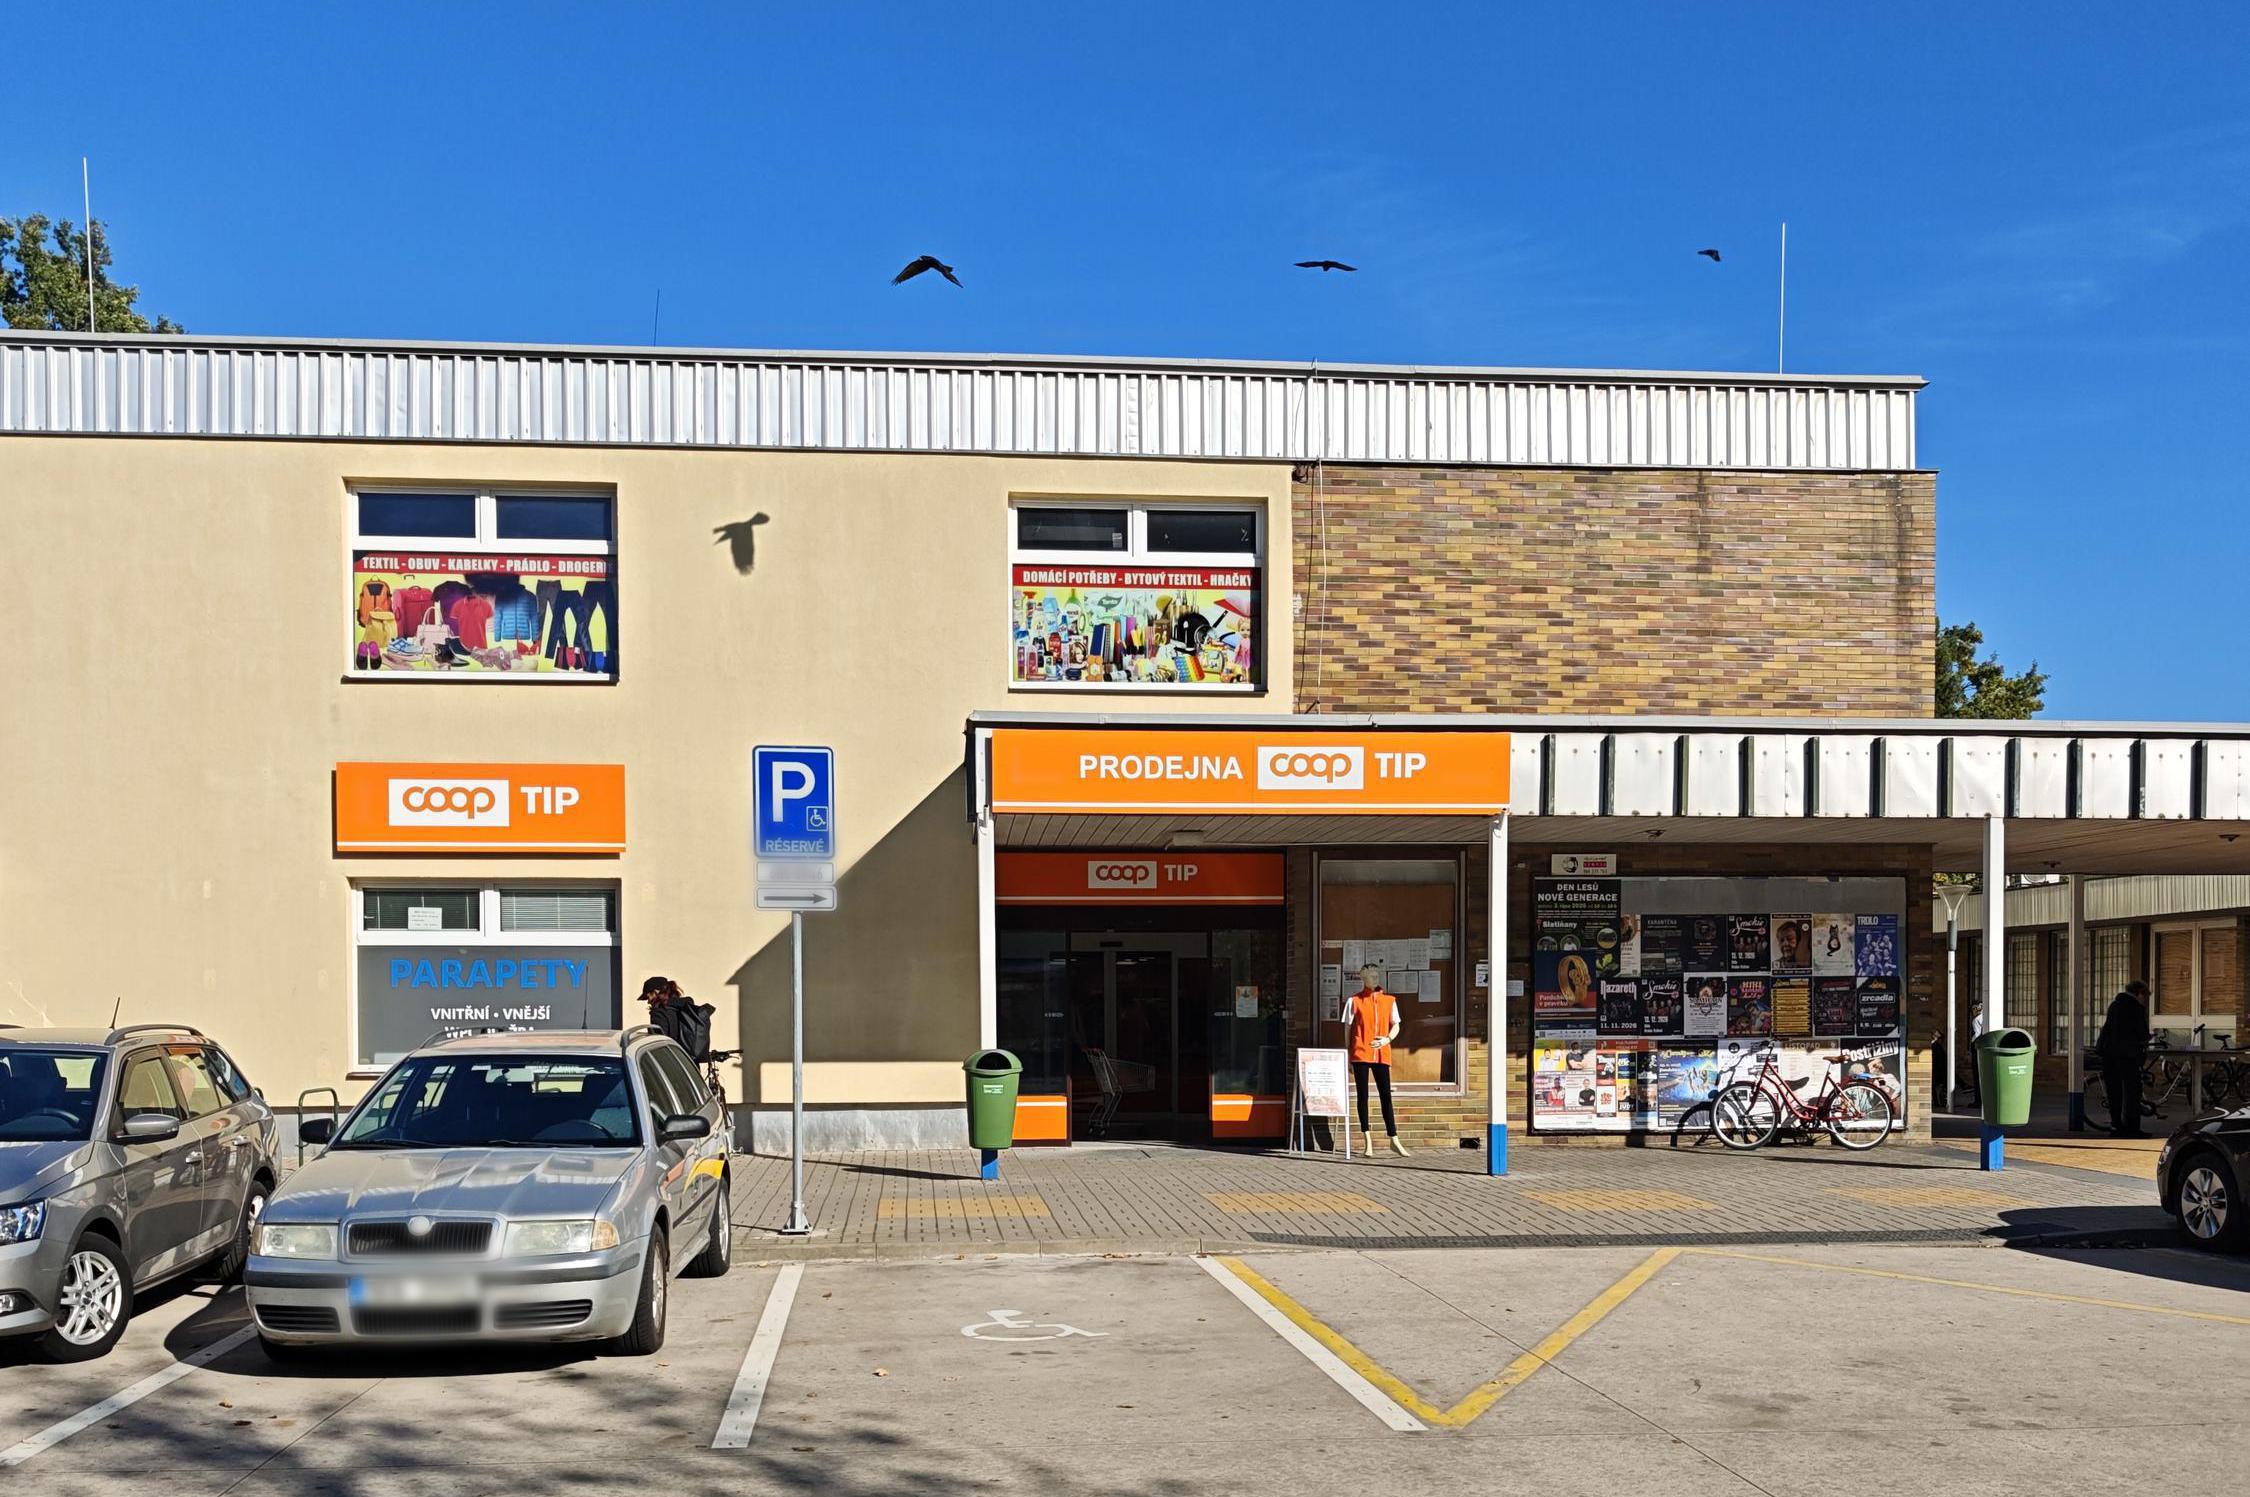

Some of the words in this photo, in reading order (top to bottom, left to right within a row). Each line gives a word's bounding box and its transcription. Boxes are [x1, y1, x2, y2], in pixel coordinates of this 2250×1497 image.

[362, 557, 400, 570] TEXTIL
[408, 557, 440, 570] OBUV
[506, 557, 550, 572] PRÁDLO
[1023, 569, 1067, 583] DOMÁCÍ
[1069, 570, 1117, 584] POTŘEBY
[1124, 571, 1167, 585] BYTOVÝ
[1168, 573, 1202, 586] TEXTIL
[1079, 755, 1244, 781] PRODEJNA
[1270, 753, 1352, 783] coop
[1374, 752, 1427, 779] TIP
[772, 761, 816, 823] P
[402, 786, 496, 819] coop
[520, 786, 580, 815] TIP
[765, 838, 825, 853] RÉSERVÉ
[1095, 864, 1149, 885] coop
[1164, 864, 1198, 881] TIP
[1577, 881, 1599, 891] LESŮ
[1537, 892, 1564, 901] NOVÉ
[1566, 893, 1618, 902] GENERACE
[390, 959, 588, 989] PARAPETY
[1600, 980, 1638, 1000] Nazareth
[431, 1005, 490, 1020] VNITŘNÍ
[503, 1005, 551, 1020] VNĚJŠÍ
[1841, 1040, 1899, 1063] Postřižiny
